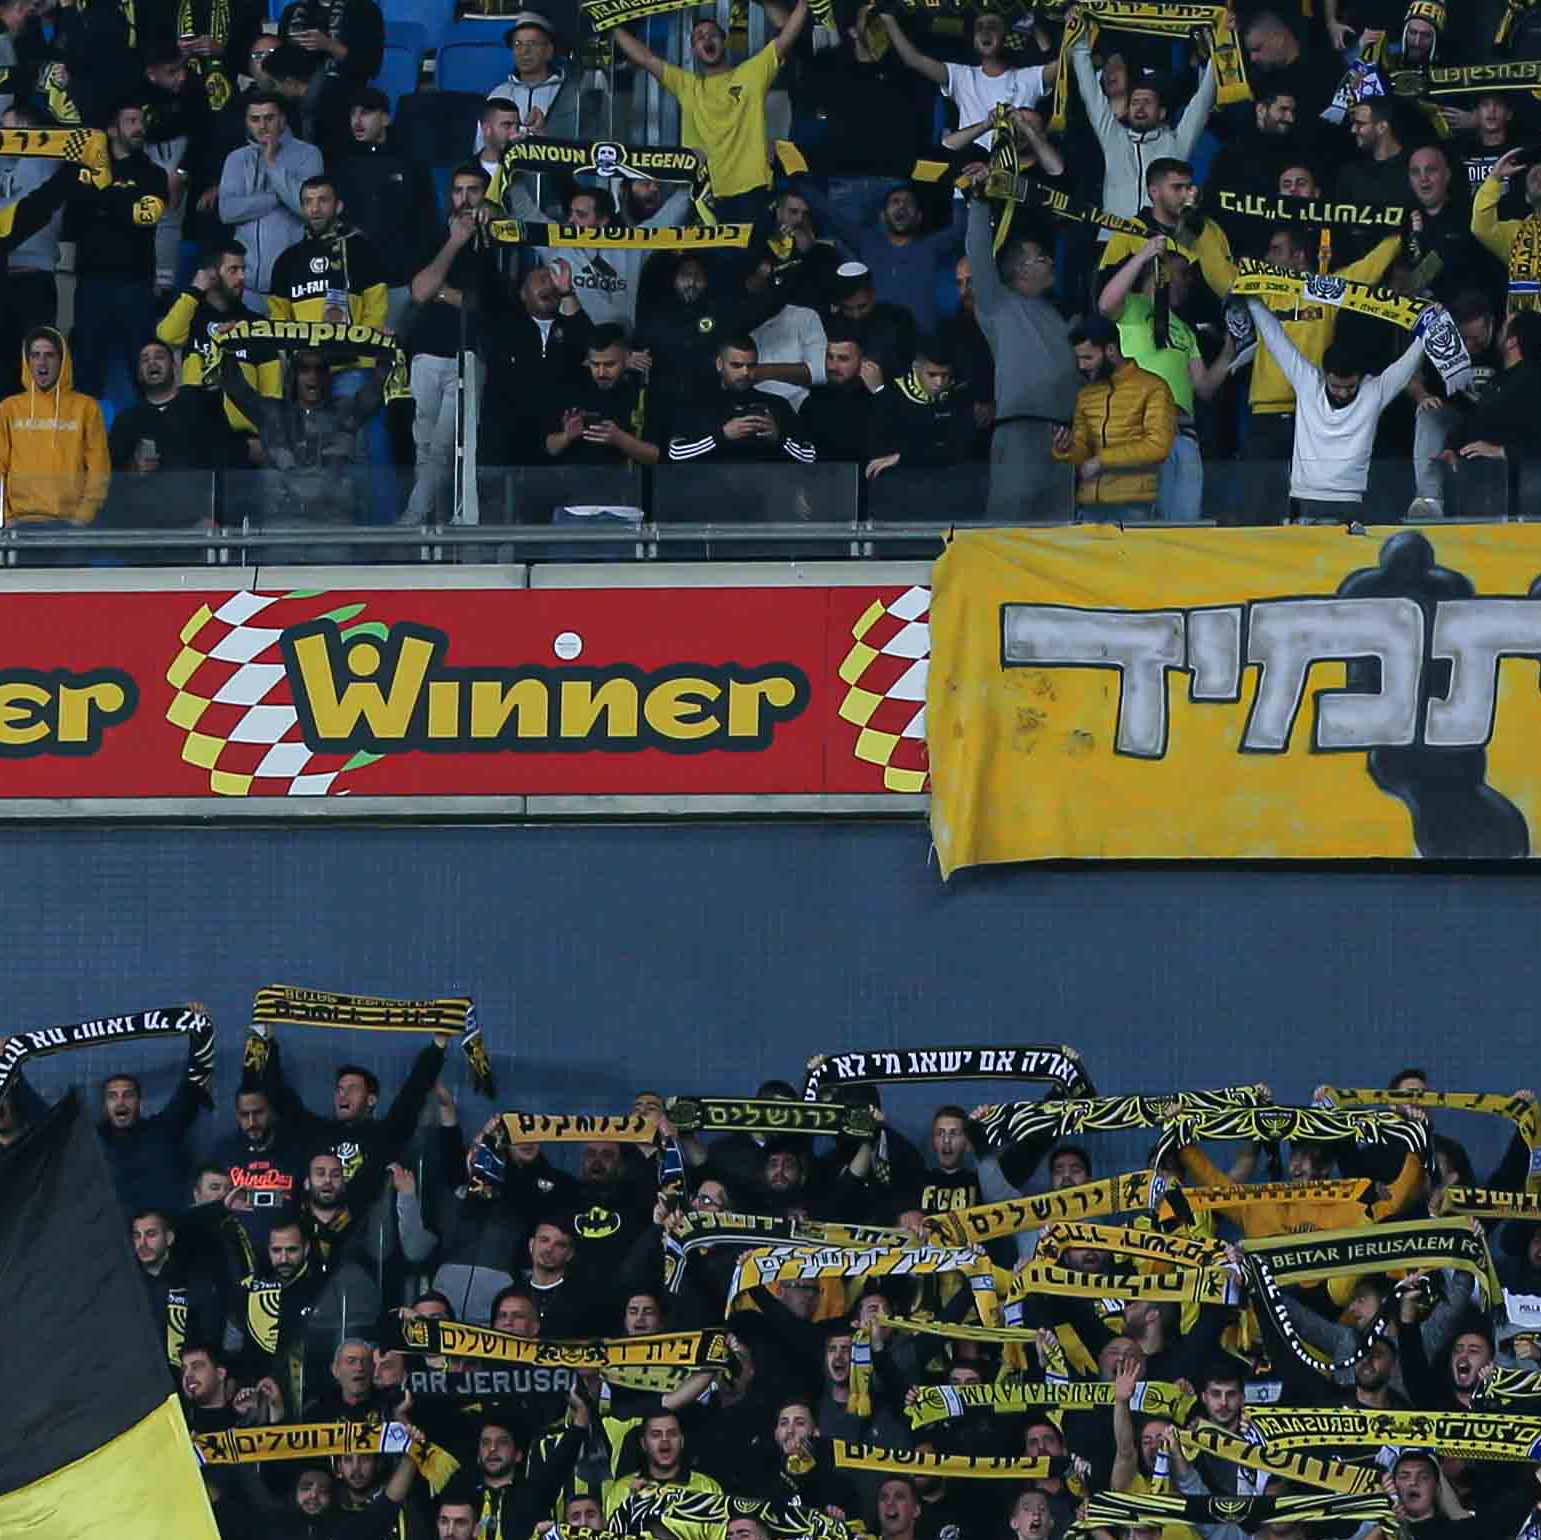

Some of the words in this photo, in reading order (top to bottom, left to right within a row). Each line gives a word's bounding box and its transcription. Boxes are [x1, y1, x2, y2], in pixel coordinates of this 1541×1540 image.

[631, 153, 696, 171] LEGEND
[1300, 201, 1404, 227] ירושלים
[295, 633, 795, 739] Winner
[871, 1053, 901, 1077] מי
[908, 1050, 974, 1073] ישאג
[993, 1050, 1016, 1072] אם
[710, 1104, 837, 1128] ירושלים
[968, 1186, 1103, 1235] ירושלים
[1271, 1248, 1340, 1268] BEITAR
[1348, 1237, 1454, 1262] JERUSALEM
[236, 1429, 344, 1455] ירושלים
